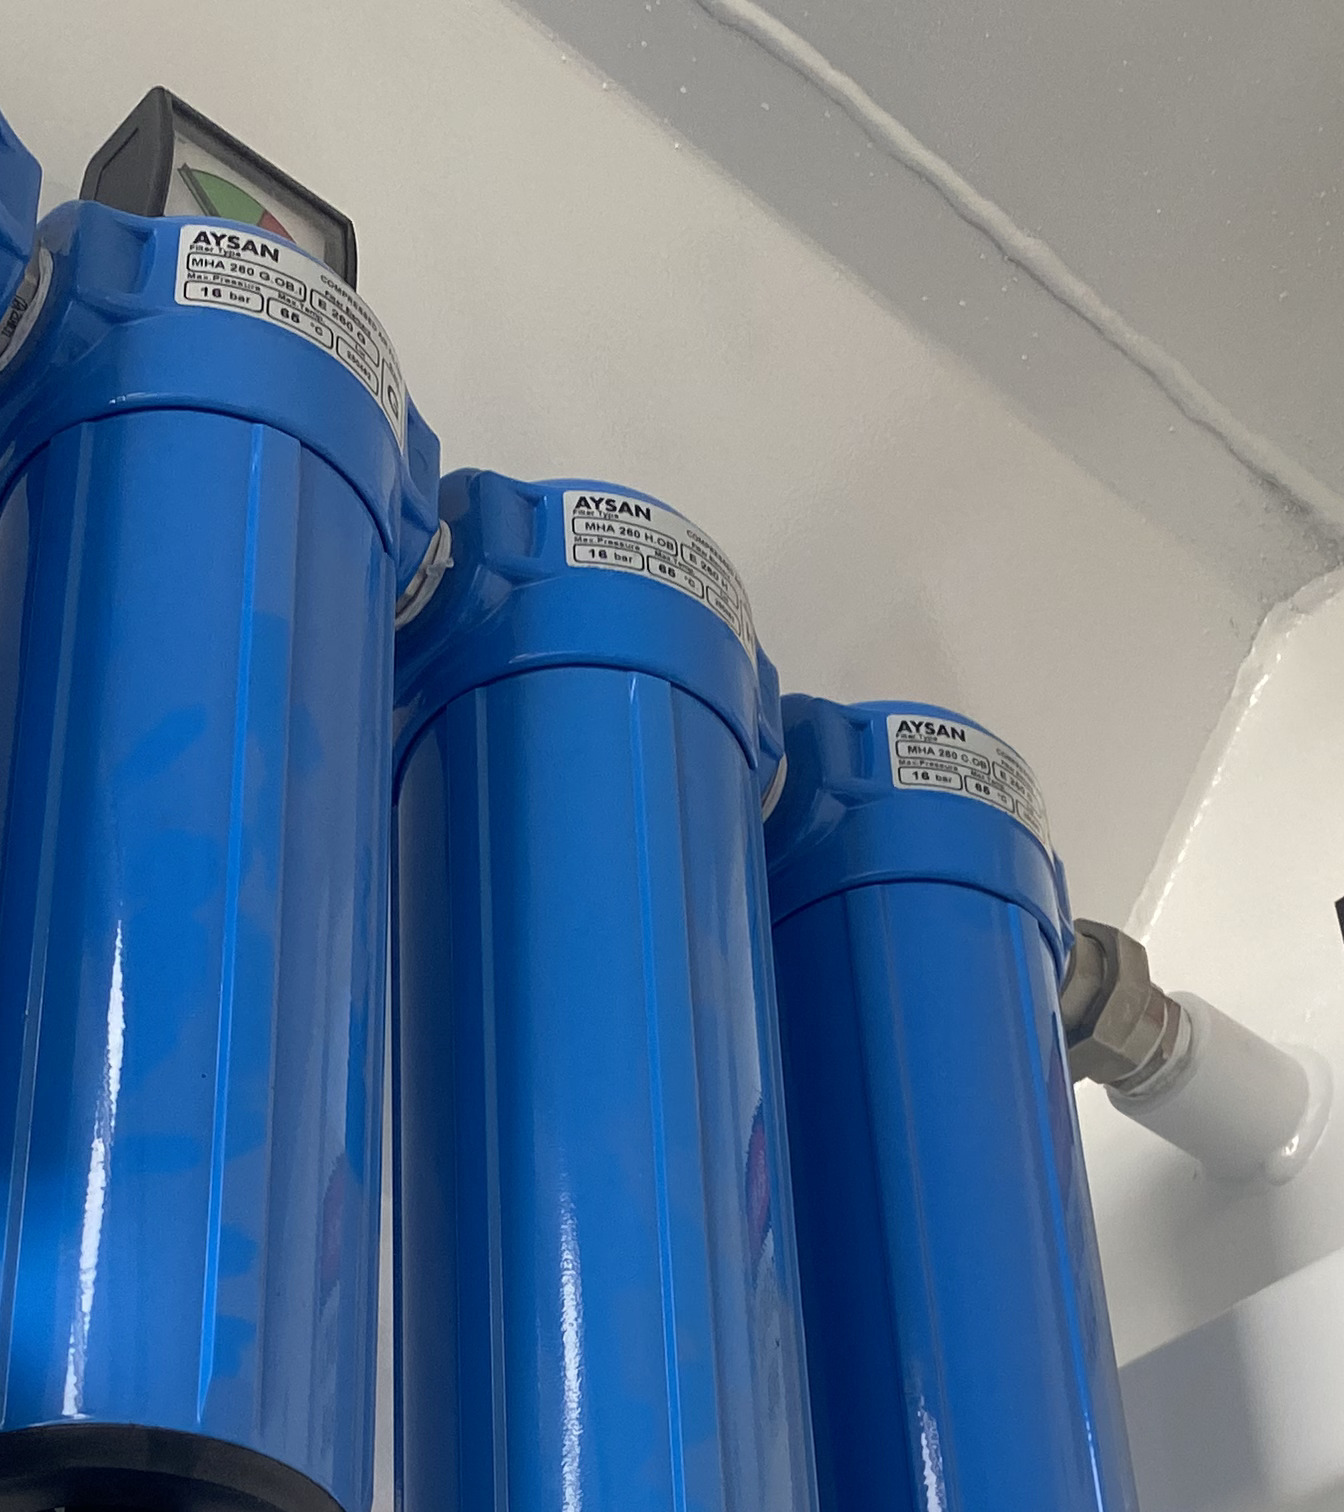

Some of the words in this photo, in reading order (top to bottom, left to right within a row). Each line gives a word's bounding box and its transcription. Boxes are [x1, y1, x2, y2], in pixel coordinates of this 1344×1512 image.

[189, 244, 214, 253] Filter
[218, 247, 241, 258] Type
[193, 231, 279, 263] AYSAN
[191, 258, 225, 269] MHA
[201, 286, 222, 298] 16
[229, 291, 250, 304] bar
[575, 496, 651, 521] AYSAN
[585, 522, 615, 533] MHA
[589, 549, 607, 559] 16
[614, 552, 633, 563] bar
[897, 720, 966, 742] AYSAN
[908, 745, 935, 755] MHA
[912, 771, 930, 780] 16
